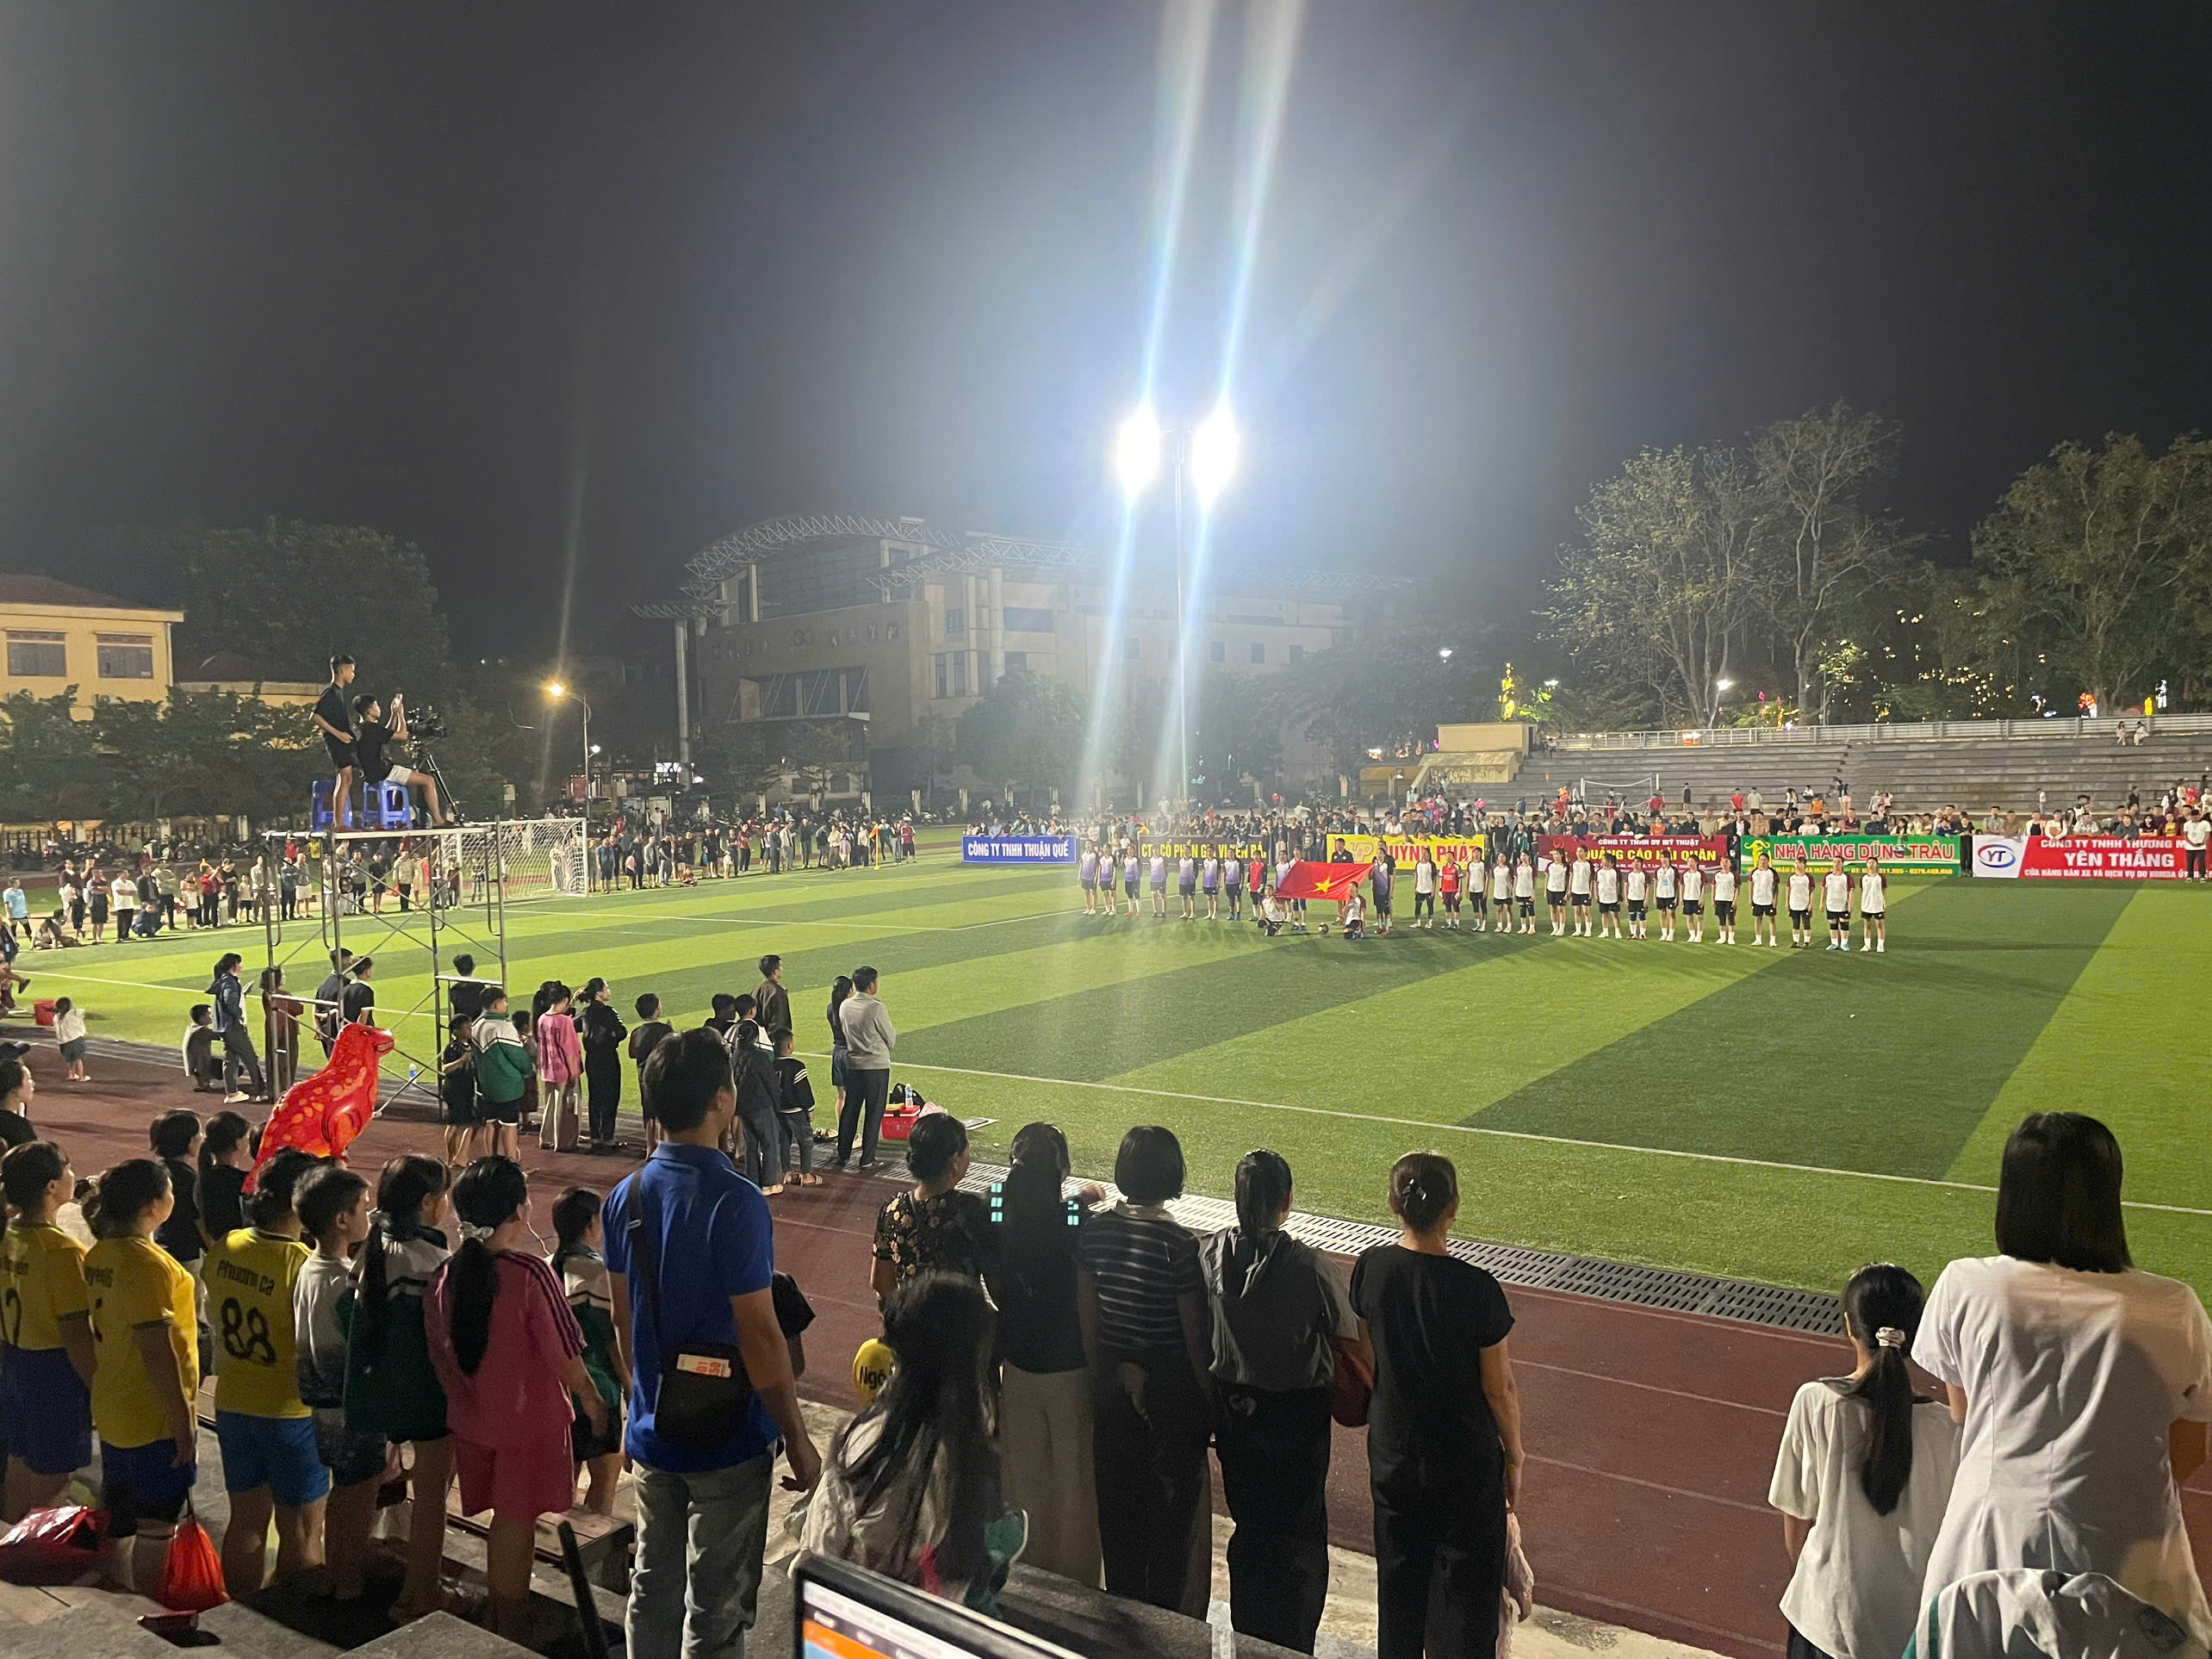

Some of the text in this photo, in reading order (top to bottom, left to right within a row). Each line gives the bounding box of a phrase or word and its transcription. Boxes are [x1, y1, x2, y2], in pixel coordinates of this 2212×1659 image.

[967, 839, 1069, 860] CÔNG TY TNHH THUẬN QUẾ
[1774, 840, 1807, 860] NHÀ
[1811, 840, 1855, 860] HÀNG
[1909, 840, 1954, 860] TRÂU
[2075, 839, 2088, 848] TY
[2091, 839, 2122, 848] TNHH
[1627, 847, 1652, 861] CÁO
[1987, 850, 2006, 862] YT
[2064, 848, 2175, 867] YÊN THẮNG
[220, 1296, 276, 1364] 88
